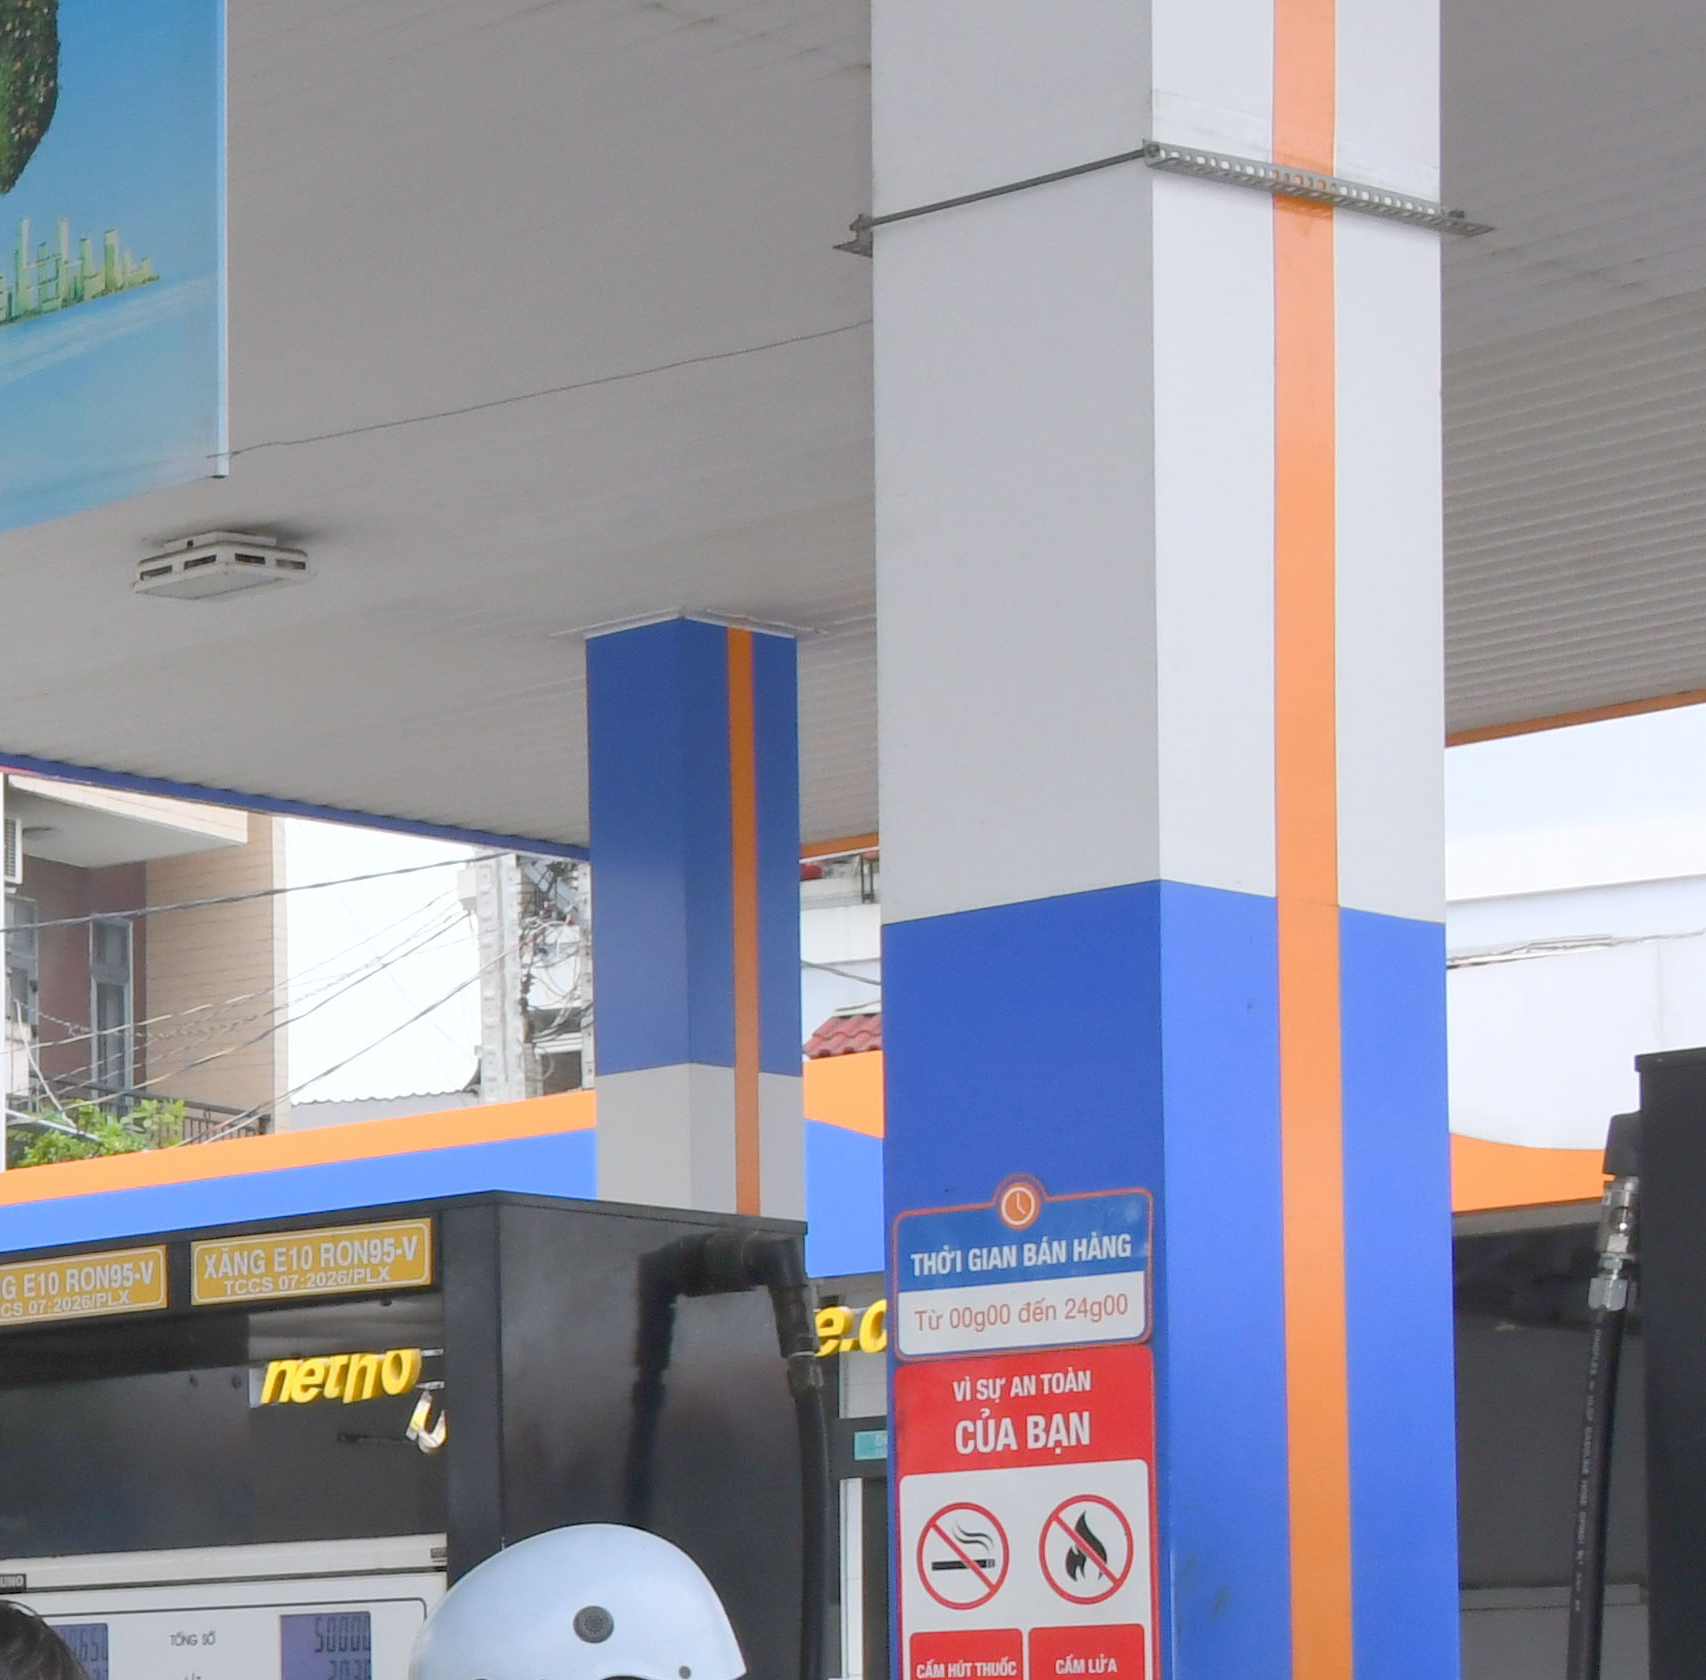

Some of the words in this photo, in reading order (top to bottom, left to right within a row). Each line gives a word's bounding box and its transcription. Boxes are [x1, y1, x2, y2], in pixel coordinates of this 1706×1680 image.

[204, 1247, 265, 1280] XĂNG
[274, 1246, 313, 1273] E10
[321, 1235, 418, 1268] RON95-V
[911, 1243, 963, 1277] THỜI
[968, 1240, 1018, 1272] GIAN
[1023, 1232, 1067, 1266] BÁN
[1073, 1229, 1132, 1261] HÀNG
[24, 1272, 59, 1297] E10
[66, 1260, 154, 1292] RON95-V
[224, 1277, 274, 1296] TCCS
[915, 1308, 942, 1333] Từ
[949, 1302, 1011, 1333] 00g00
[1018, 1297, 1057, 1324] đến
[1064, 1293, 1128, 1324] 24g00
[952, 1374, 972, 1403] VÌ
[976, 1375, 1006, 1403] SỰ
[1010, 1375, 1037, 1397] AN
[1041, 1367, 1092, 1395] TOÀN
[955, 1408, 1018, 1454] CỦA
[1026, 1411, 1091, 1455] BẠN
[916, 1654, 944, 1680] CẤM
[946, 1655, 973, 1678] HÚT
[975, 1654, 1017, 1677] THUỐC
[1055, 1652, 1086, 1676] CẤM
[1088, 1653, 1118, 1674] LỬA
